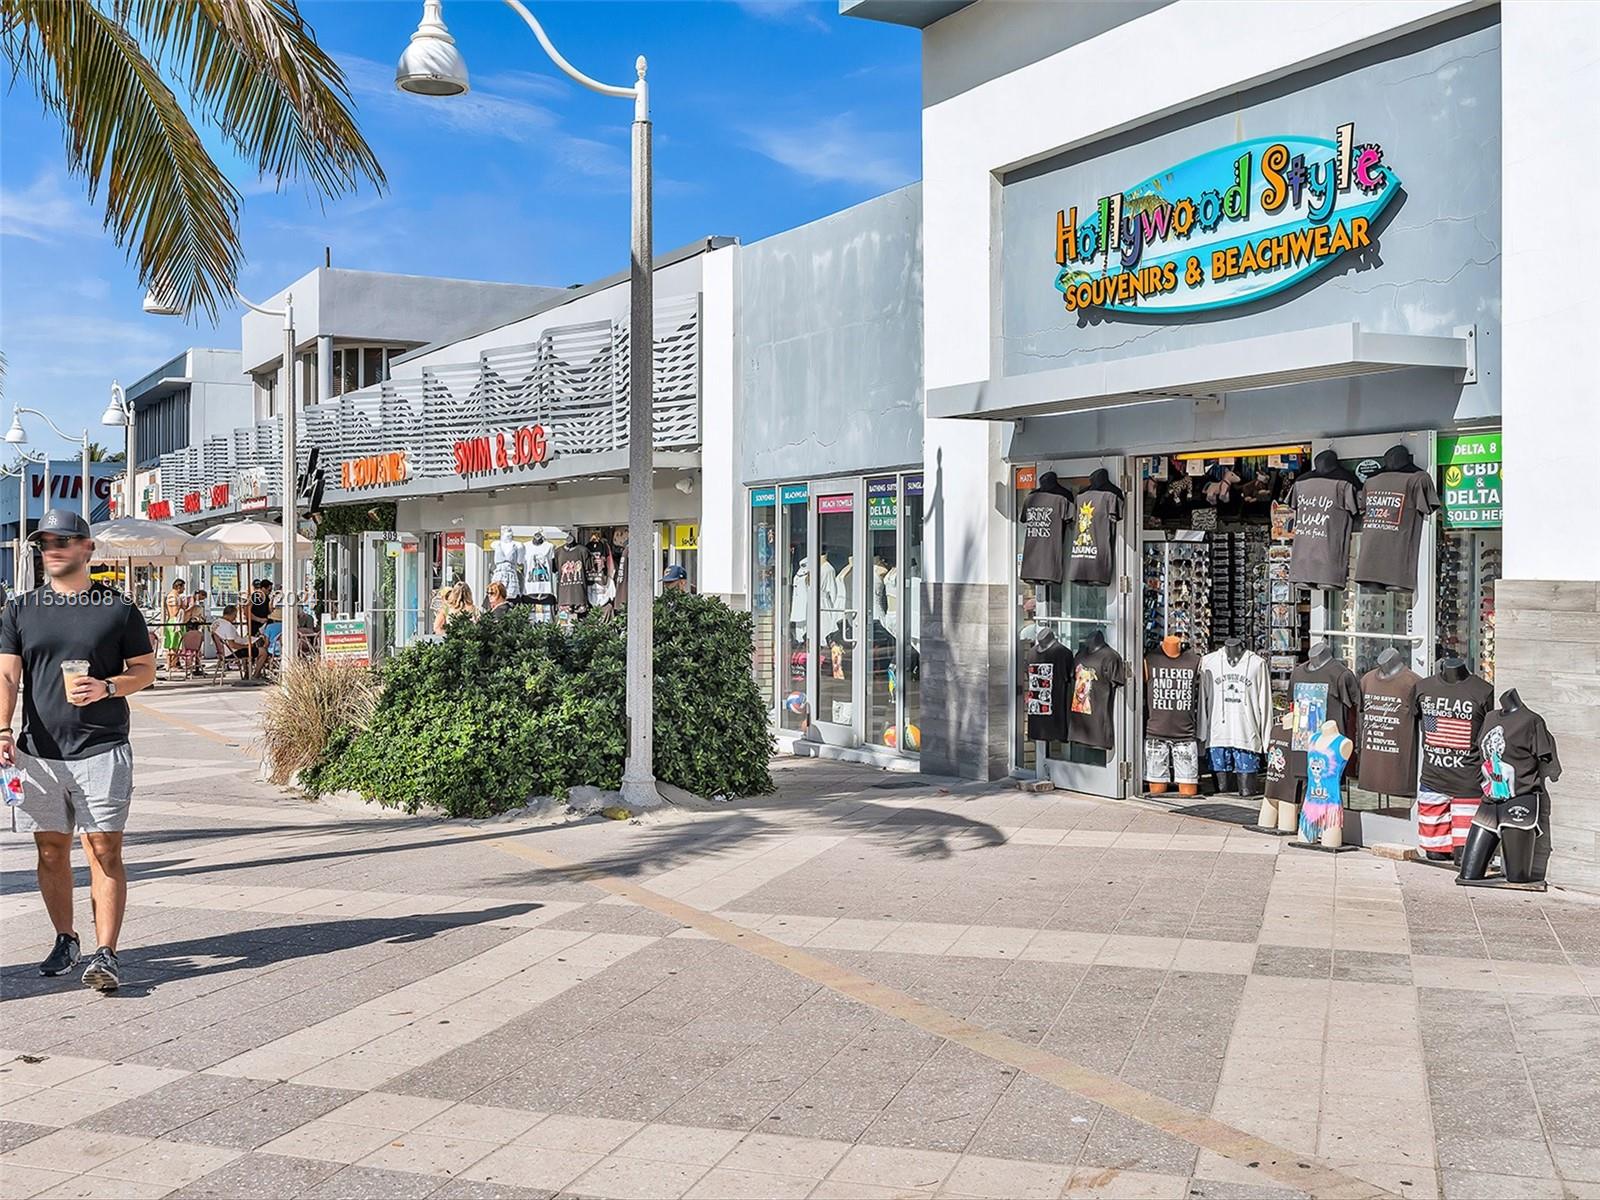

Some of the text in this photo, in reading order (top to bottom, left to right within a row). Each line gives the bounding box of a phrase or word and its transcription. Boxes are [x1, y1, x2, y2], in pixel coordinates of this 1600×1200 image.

[1055, 122, 1386, 266] Hollywood Style
[1064, 217, 1371, 312] SOUVENIRS & BEACHWEAR
[454, 424, 547, 475] SWIM & JOG
[1454, 442, 1497, 455] DELTA 8
[353, 451, 407, 487] SOUVENIRS
[1463, 463, 1499, 476] CBD
[1476, 477, 1485, 487] &
[1446, 489, 1500, 504] DELTA
[1297, 494, 1334, 512] Shut Up
[870, 505, 897, 516] DELTA 8
[1447, 510, 1503, 522] SOLD HER
[382, 532, 398, 541] 309
[1027, 528, 1051, 537] HINGS
[1152, 668, 1194, 679] I FLEXED
[1153, 679, 1192, 690] AND THE
[1153, 689, 1192, 700] SLEEVES
[1153, 699, 1192, 711] FELL OFF
[1436, 697, 1473, 714] FLAG
[1364, 714, 1400, 724] AUGHTER
[1455, 711, 1473, 720] YOU
[1310, 786, 1329, 797] LOL
